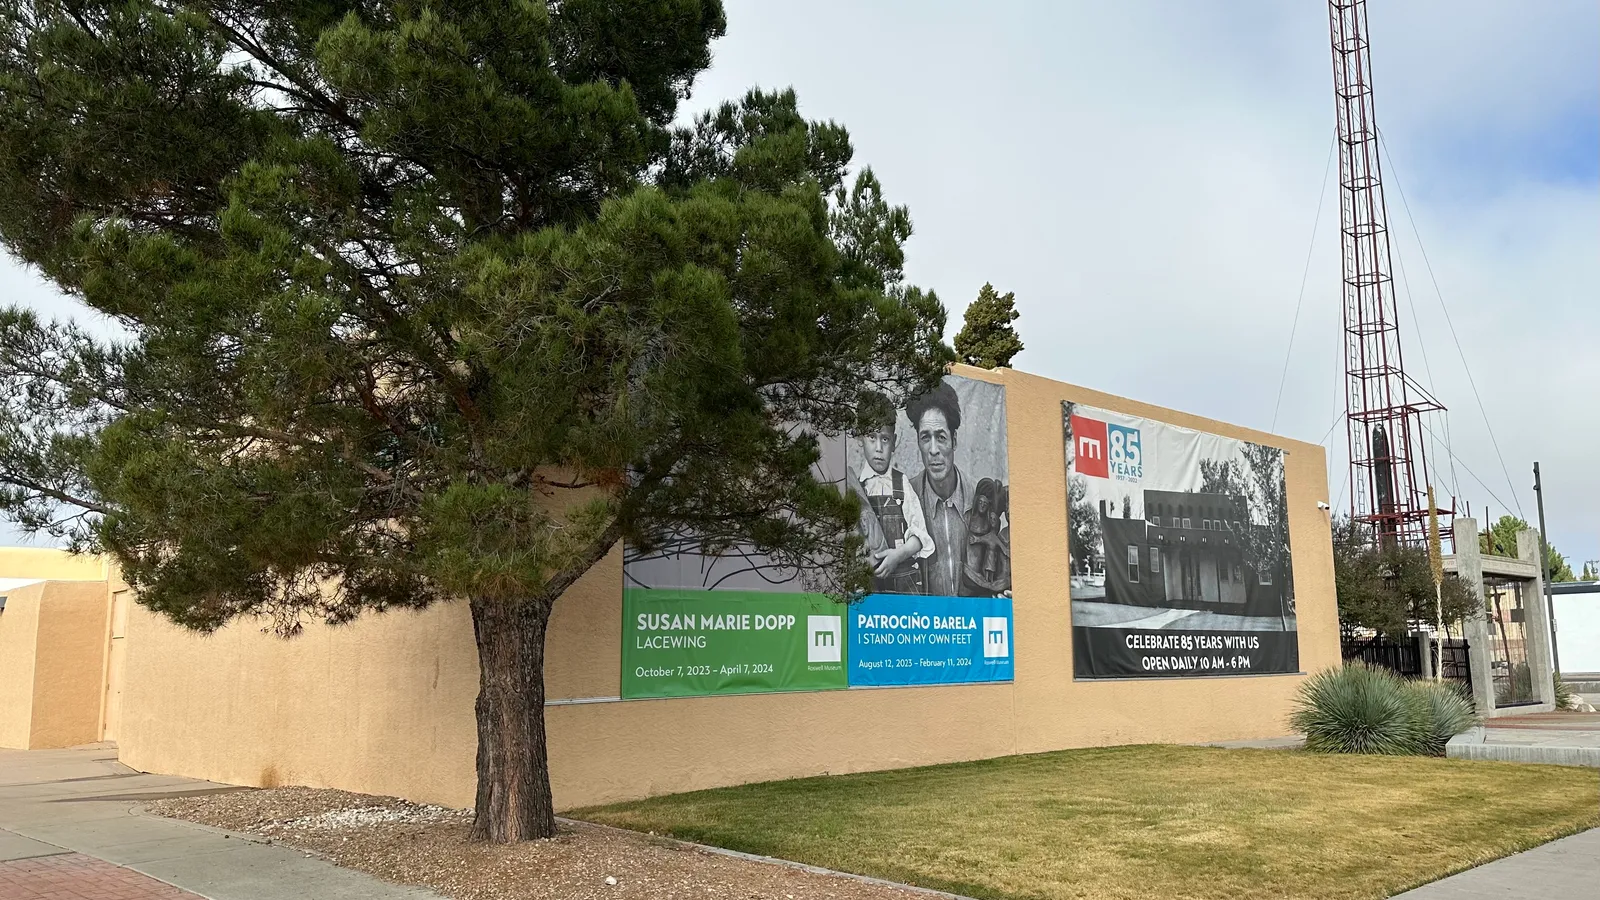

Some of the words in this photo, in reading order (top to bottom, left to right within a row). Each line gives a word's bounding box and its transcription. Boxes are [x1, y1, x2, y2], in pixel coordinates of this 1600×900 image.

[1110, 430, 1140, 465] 85
[1109, 461, 1143, 478] YEARS
[637, 613, 696, 631] SUSAN
[700, 614, 750, 630] MARIE
[754, 615, 796, 630] DOPP
[857, 612, 931, 630] PATROCIÑO
[933, 616, 977, 630] BARELA
[636, 635, 707, 649] LACEWING
[858, 633, 861, 644] I
[863, 633, 894, 645] STAND
[896, 633, 911, 645] ON
[913, 633, 927, 644] MY
[928, 633, 950, 645] OWN
[952, 633, 972, 645] FEET
[1125, 634, 1180, 649] CELEBRATE
[1180, 634, 1192, 650] 85
[1194, 635, 1223, 649] YEARS
[1224, 636, 1247, 649] WITH
[1248, 636, 1260, 649] US
[858, 659, 883, 670] August
[884, 659, 894, 668] 12,
[896, 659, 913, 668] 2023
[920, 658, 946, 669] February
[947, 658, 955, 667] 11,
[956, 658, 972, 666] 2024
[1142, 656, 1170, 670] OPEN
[1170, 656, 1198, 670] DAILY
[1199, 656, 1210, 670] 10
[1212, 656, 1225, 669] AM
[1231, 656, 1236, 668] 6
[1238, 656, 1250, 668] PM
[635, 666, 674, 678] October
[677, 666, 684, 678] 7,
[687, 665, 711, 676] 2023
[720, 664, 742, 677] April
[744, 664, 750, 676] 7,
[752, 664, 774, 674] 2024
